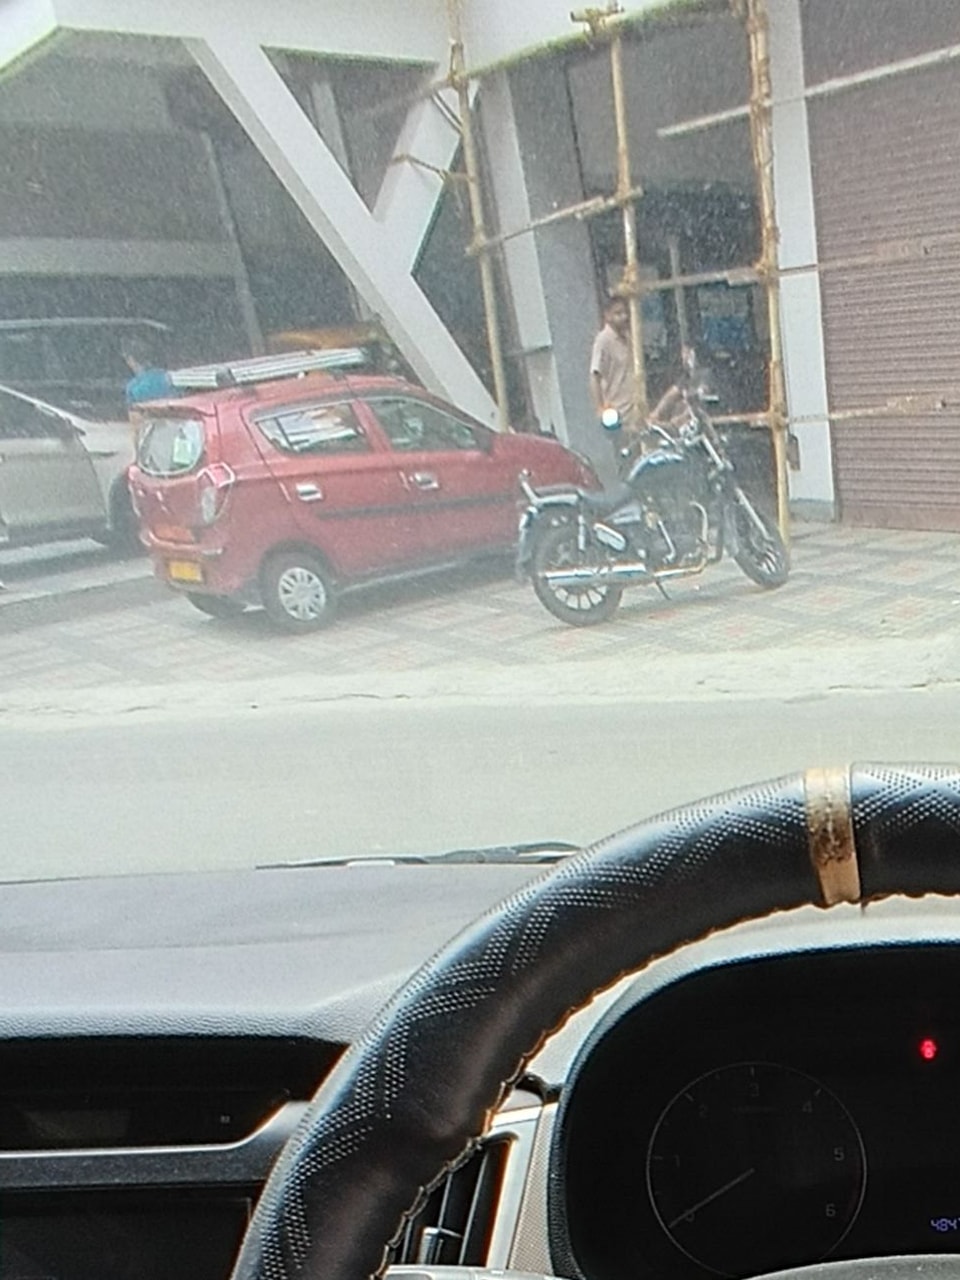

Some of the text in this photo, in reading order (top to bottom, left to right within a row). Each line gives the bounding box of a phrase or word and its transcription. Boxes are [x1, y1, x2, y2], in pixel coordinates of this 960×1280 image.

[749, 1083, 759, 1097] 3
[802, 1099, 813, 1113] 4
[833, 1146, 845, 1161] 5
[825, 1203, 836, 1217] 6
